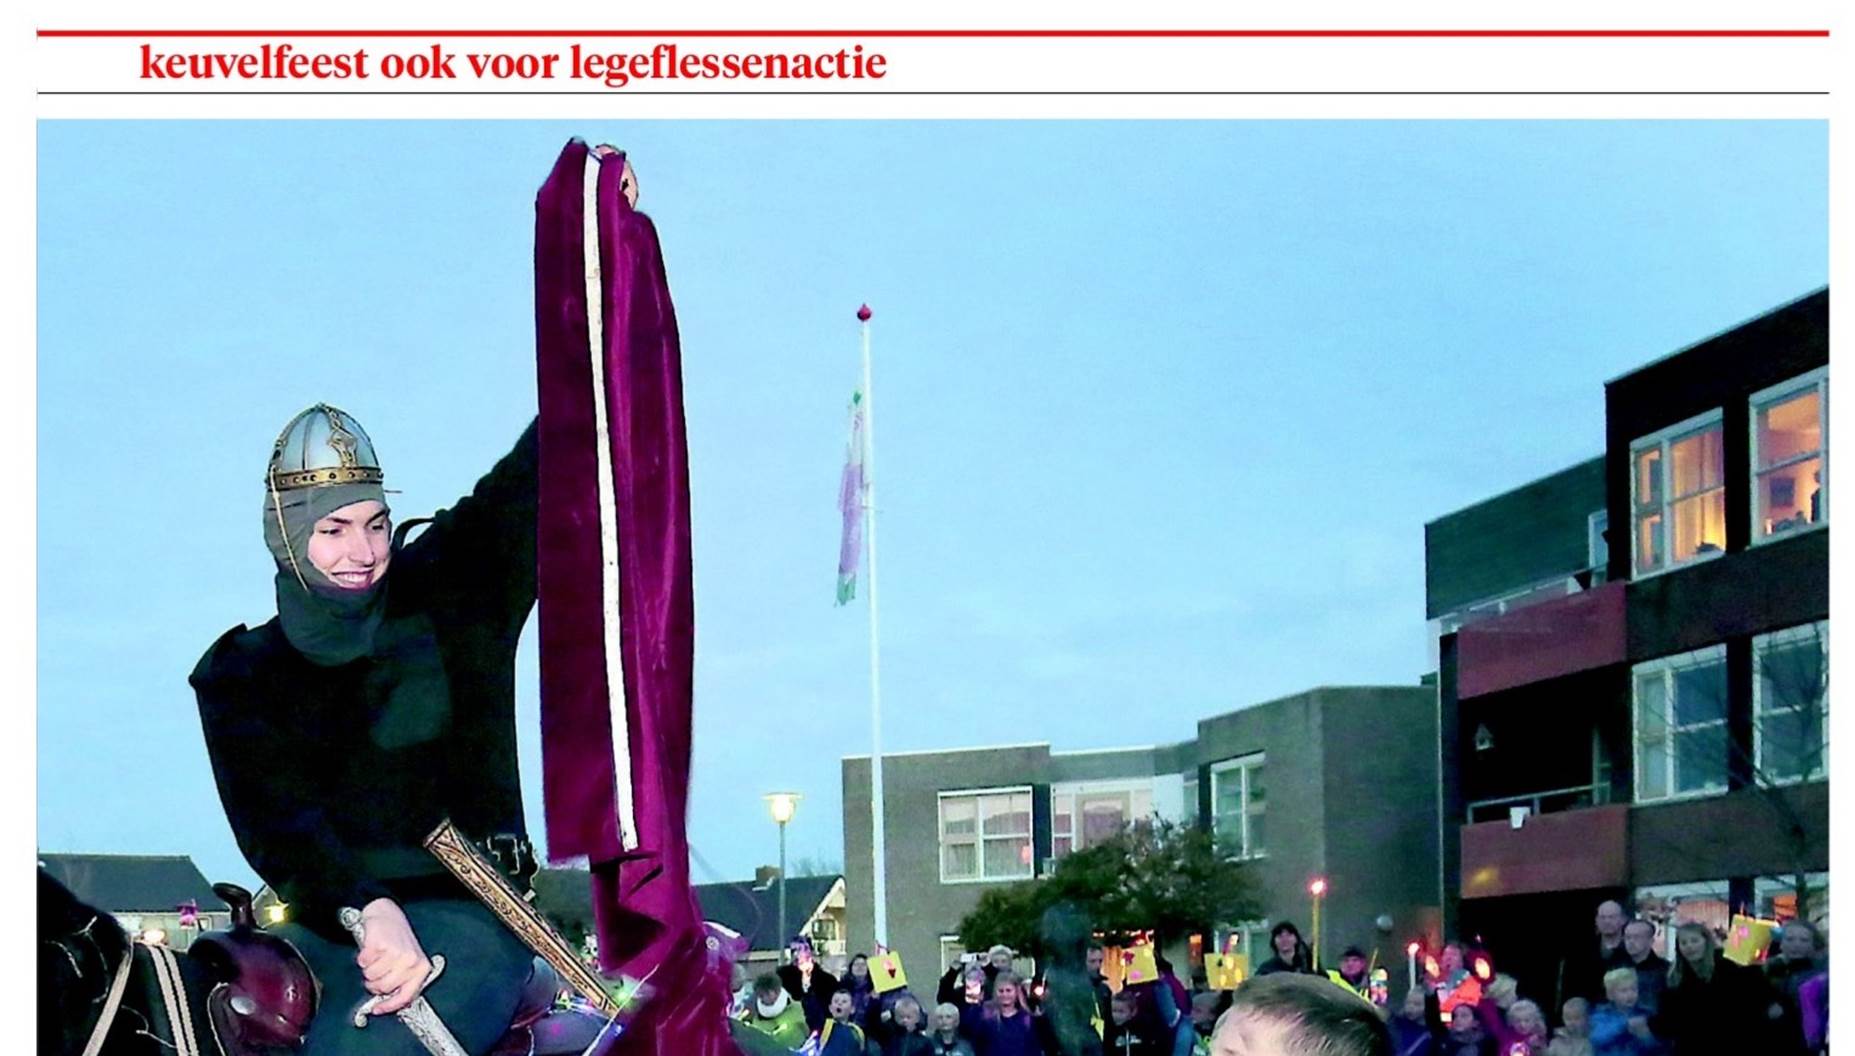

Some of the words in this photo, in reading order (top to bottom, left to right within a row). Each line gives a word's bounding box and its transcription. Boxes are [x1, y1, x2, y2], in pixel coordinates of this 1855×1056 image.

[140, 43, 370, 79] keuvelfeest
[380, 43, 457, 79] ook
[466, 53, 560, 79] voor
[570, 43, 887, 89] legeflessenactie
